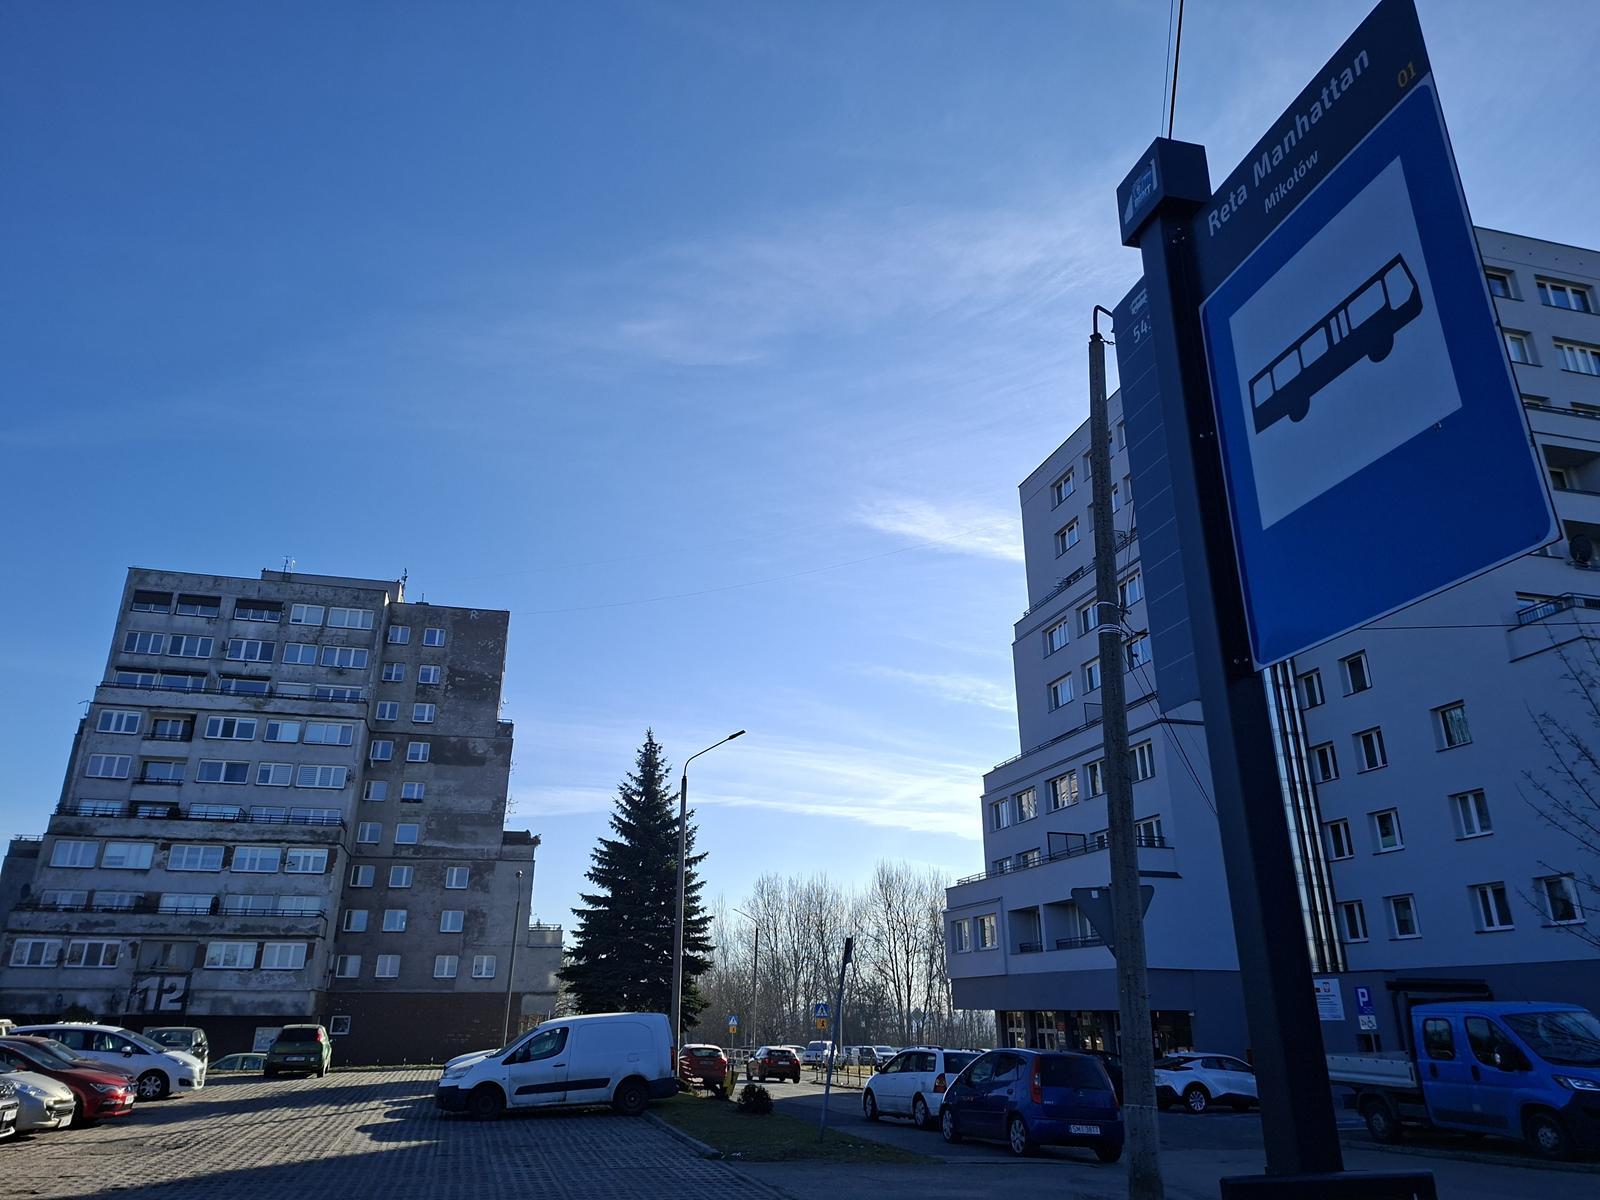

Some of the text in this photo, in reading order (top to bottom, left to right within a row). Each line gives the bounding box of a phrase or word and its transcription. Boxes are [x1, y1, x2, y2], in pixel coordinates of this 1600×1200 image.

[1397, 61, 1417, 89] 01
[1207, 49, 1370, 237] Reta Manhattan
[1264, 150, 1320, 214] Mikołów
[136, 976, 187, 1011] 12
[1357, 988, 1369, 1007] P
